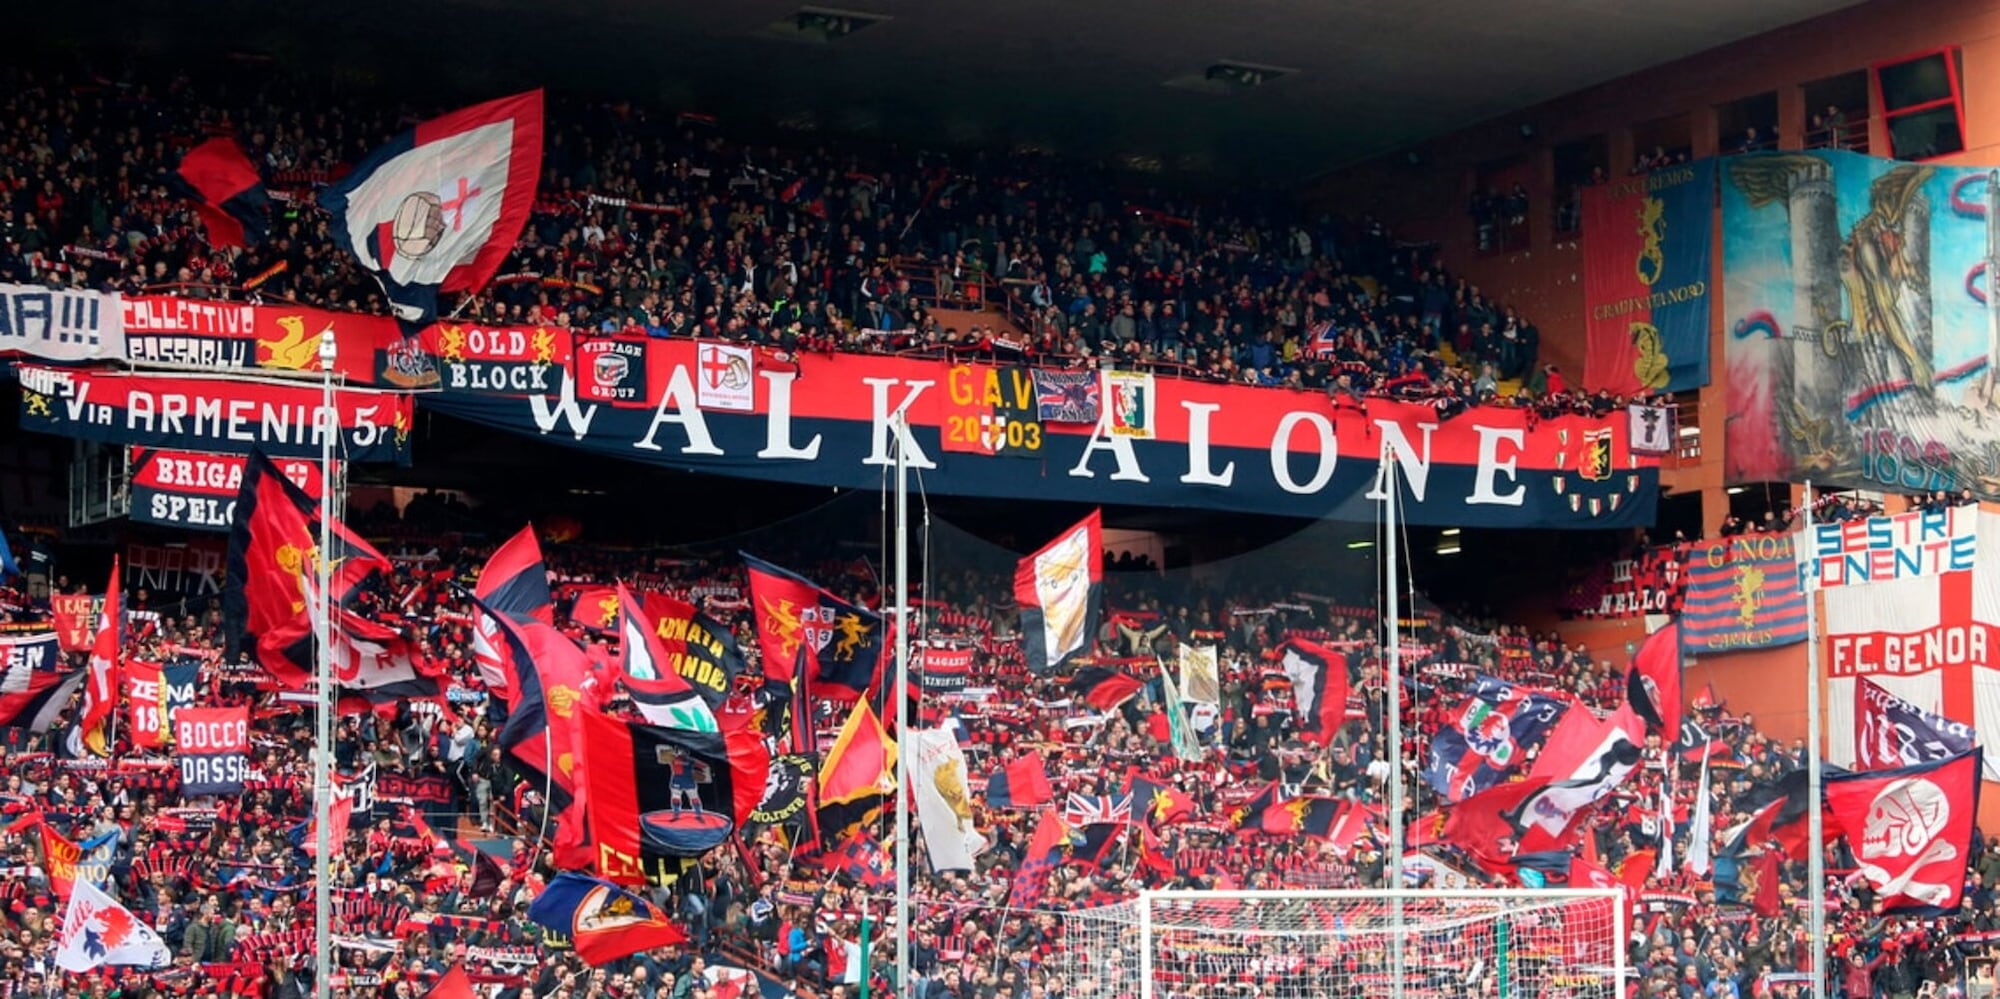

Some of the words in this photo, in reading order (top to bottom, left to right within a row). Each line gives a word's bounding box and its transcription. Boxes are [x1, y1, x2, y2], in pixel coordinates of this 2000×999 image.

[123, 300, 255, 334] COLLETTIVO
[468, 330, 526, 355] OLD
[582, 341, 643, 357] VINTAGE
[450, 364, 549, 391] BLOCK
[591, 385, 636, 398] GROUP
[127, 390, 338, 446] ARMENIA
[1817, 506, 1953, 556] SESTRI
[1798, 534, 1975, 589] PONENTE
[1834, 636, 1879, 674] F.C.
[1884, 625, 1987, 673] GENOA
[180, 720, 248, 749] BOCCA
